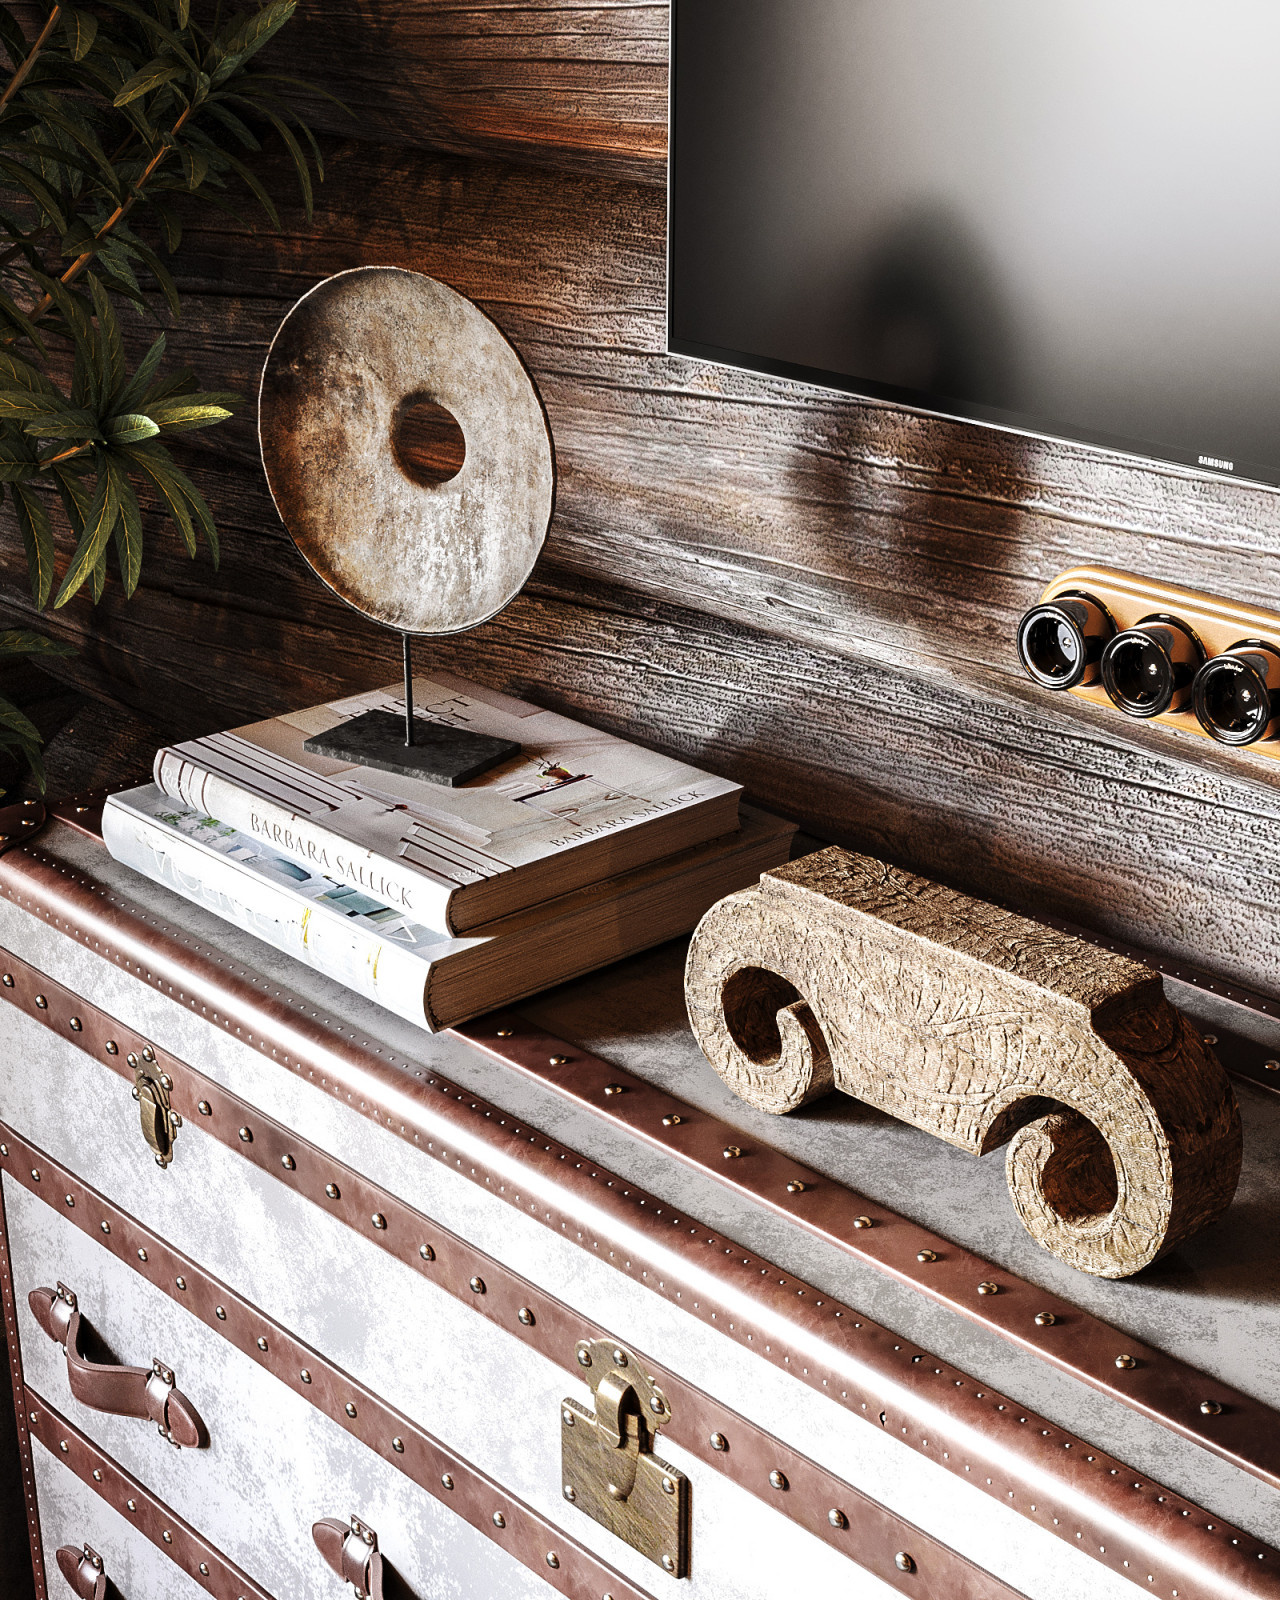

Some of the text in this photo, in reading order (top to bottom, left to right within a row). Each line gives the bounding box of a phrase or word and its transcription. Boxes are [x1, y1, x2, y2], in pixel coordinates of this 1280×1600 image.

[1198, 455, 1234, 471] SAMSUNG
[549, 790, 706, 847] BARBARA SALLICK
[250, 812, 413, 909] BARBARA SALLICK
